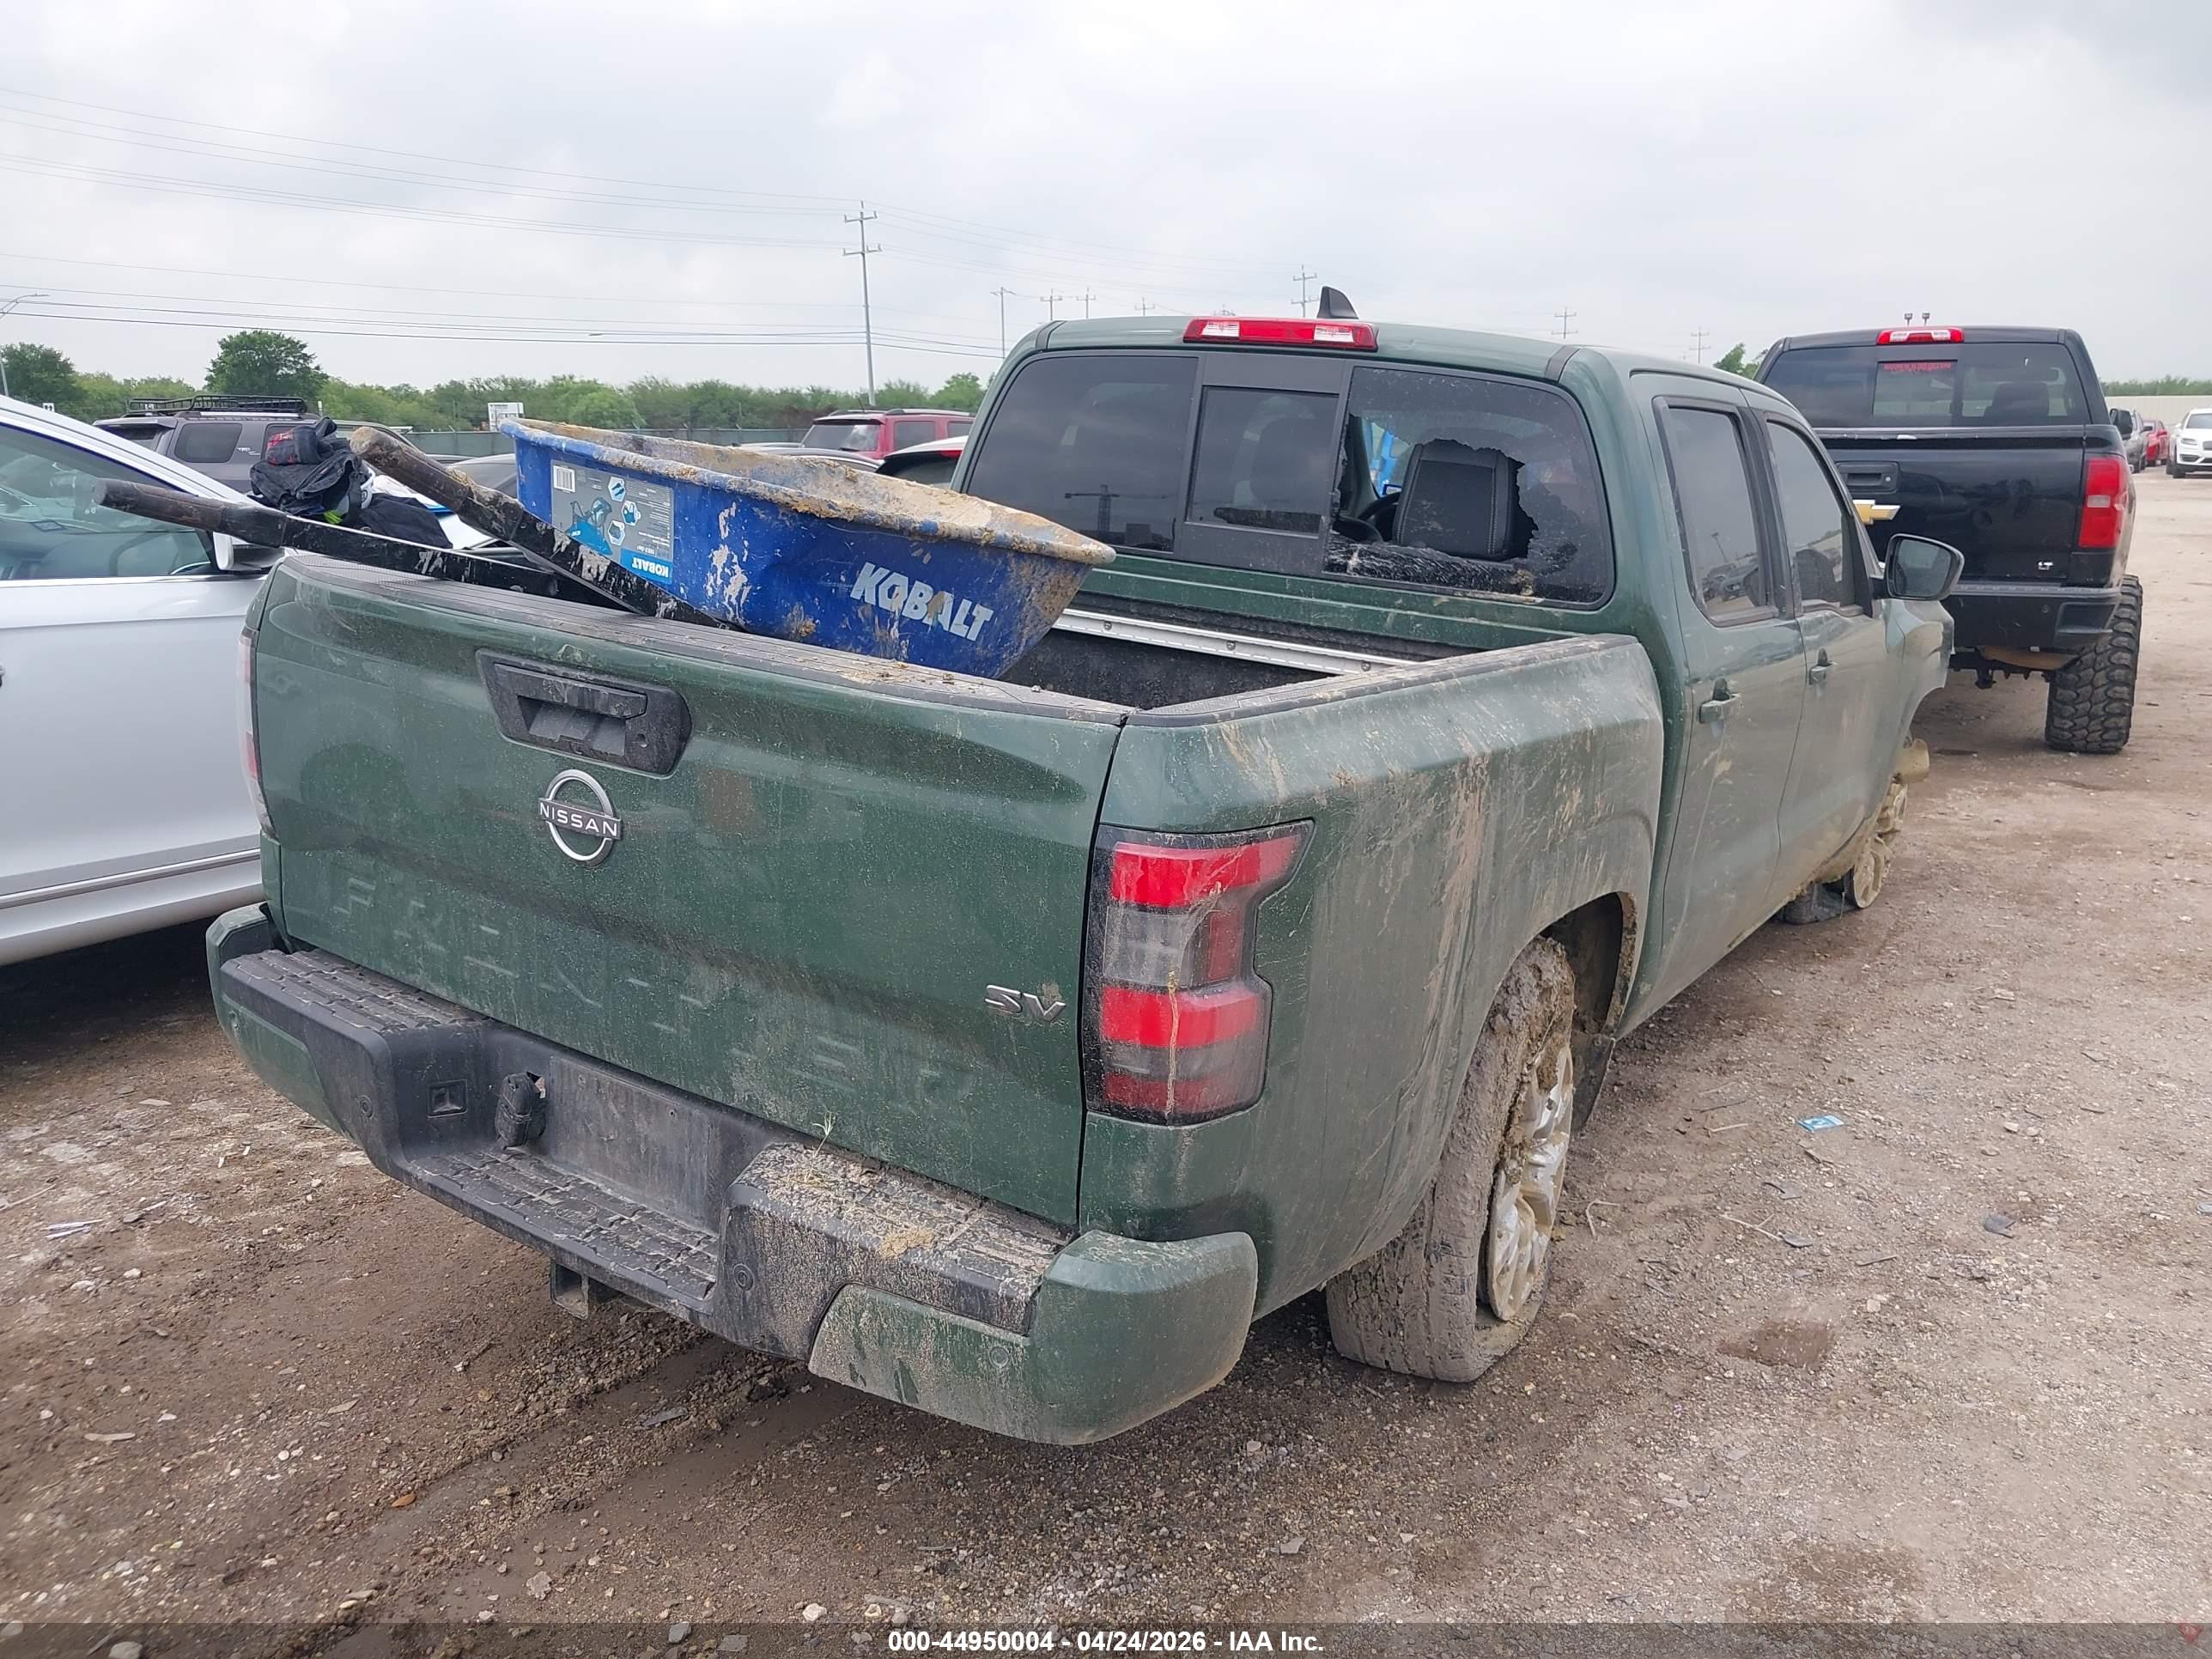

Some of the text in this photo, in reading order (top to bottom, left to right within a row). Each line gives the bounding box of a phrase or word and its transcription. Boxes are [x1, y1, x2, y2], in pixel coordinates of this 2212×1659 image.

[631, 556, 669, 578] KOBALT
[849, 561, 995, 642] KOBALT
[540, 801, 618, 838] NISSAN
[984, 983, 1066, 1022] SV
